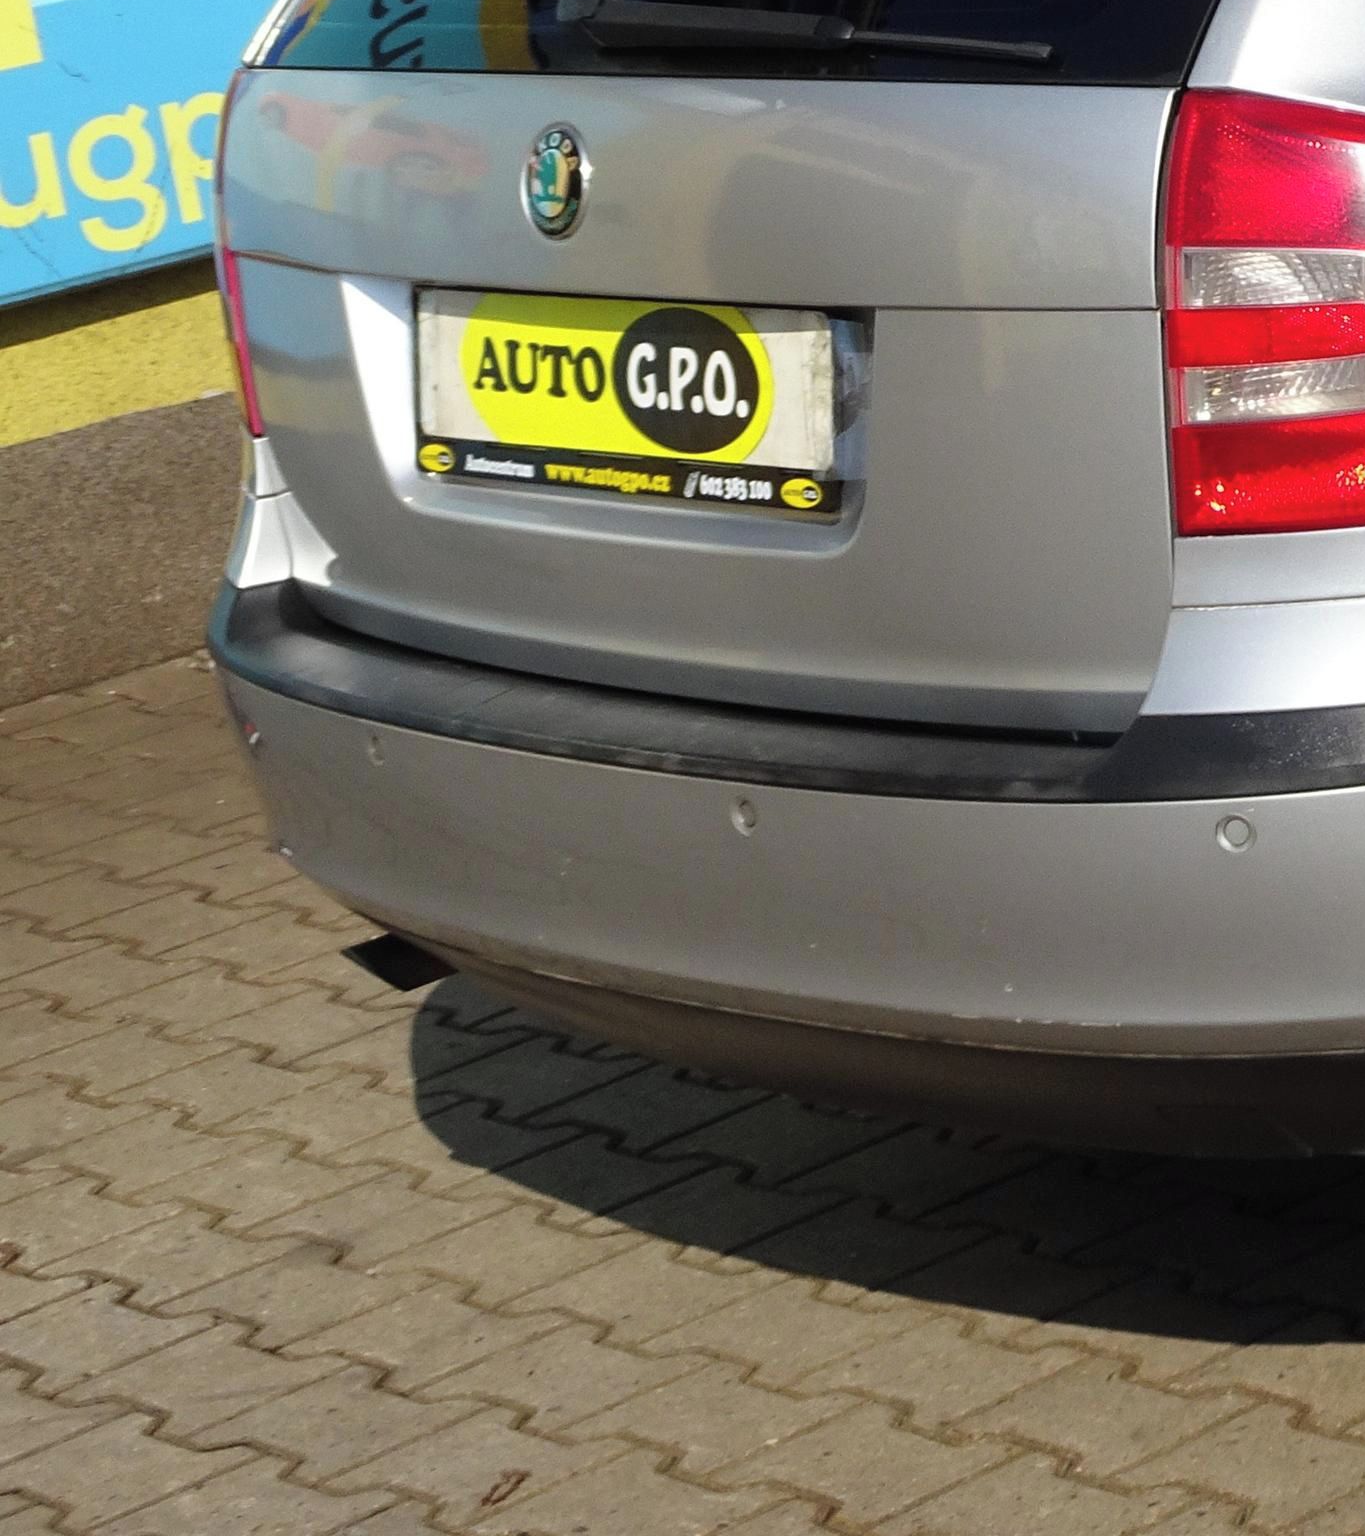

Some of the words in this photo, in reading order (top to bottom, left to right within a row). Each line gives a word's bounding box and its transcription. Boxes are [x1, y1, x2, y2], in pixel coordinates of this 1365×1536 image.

[473, 336, 606, 403] AUTO
[626, 341, 750, 419] G.P.O.
[543, 463, 672, 495] www.autogpo.cz
[748, 479, 774, 501] 100
